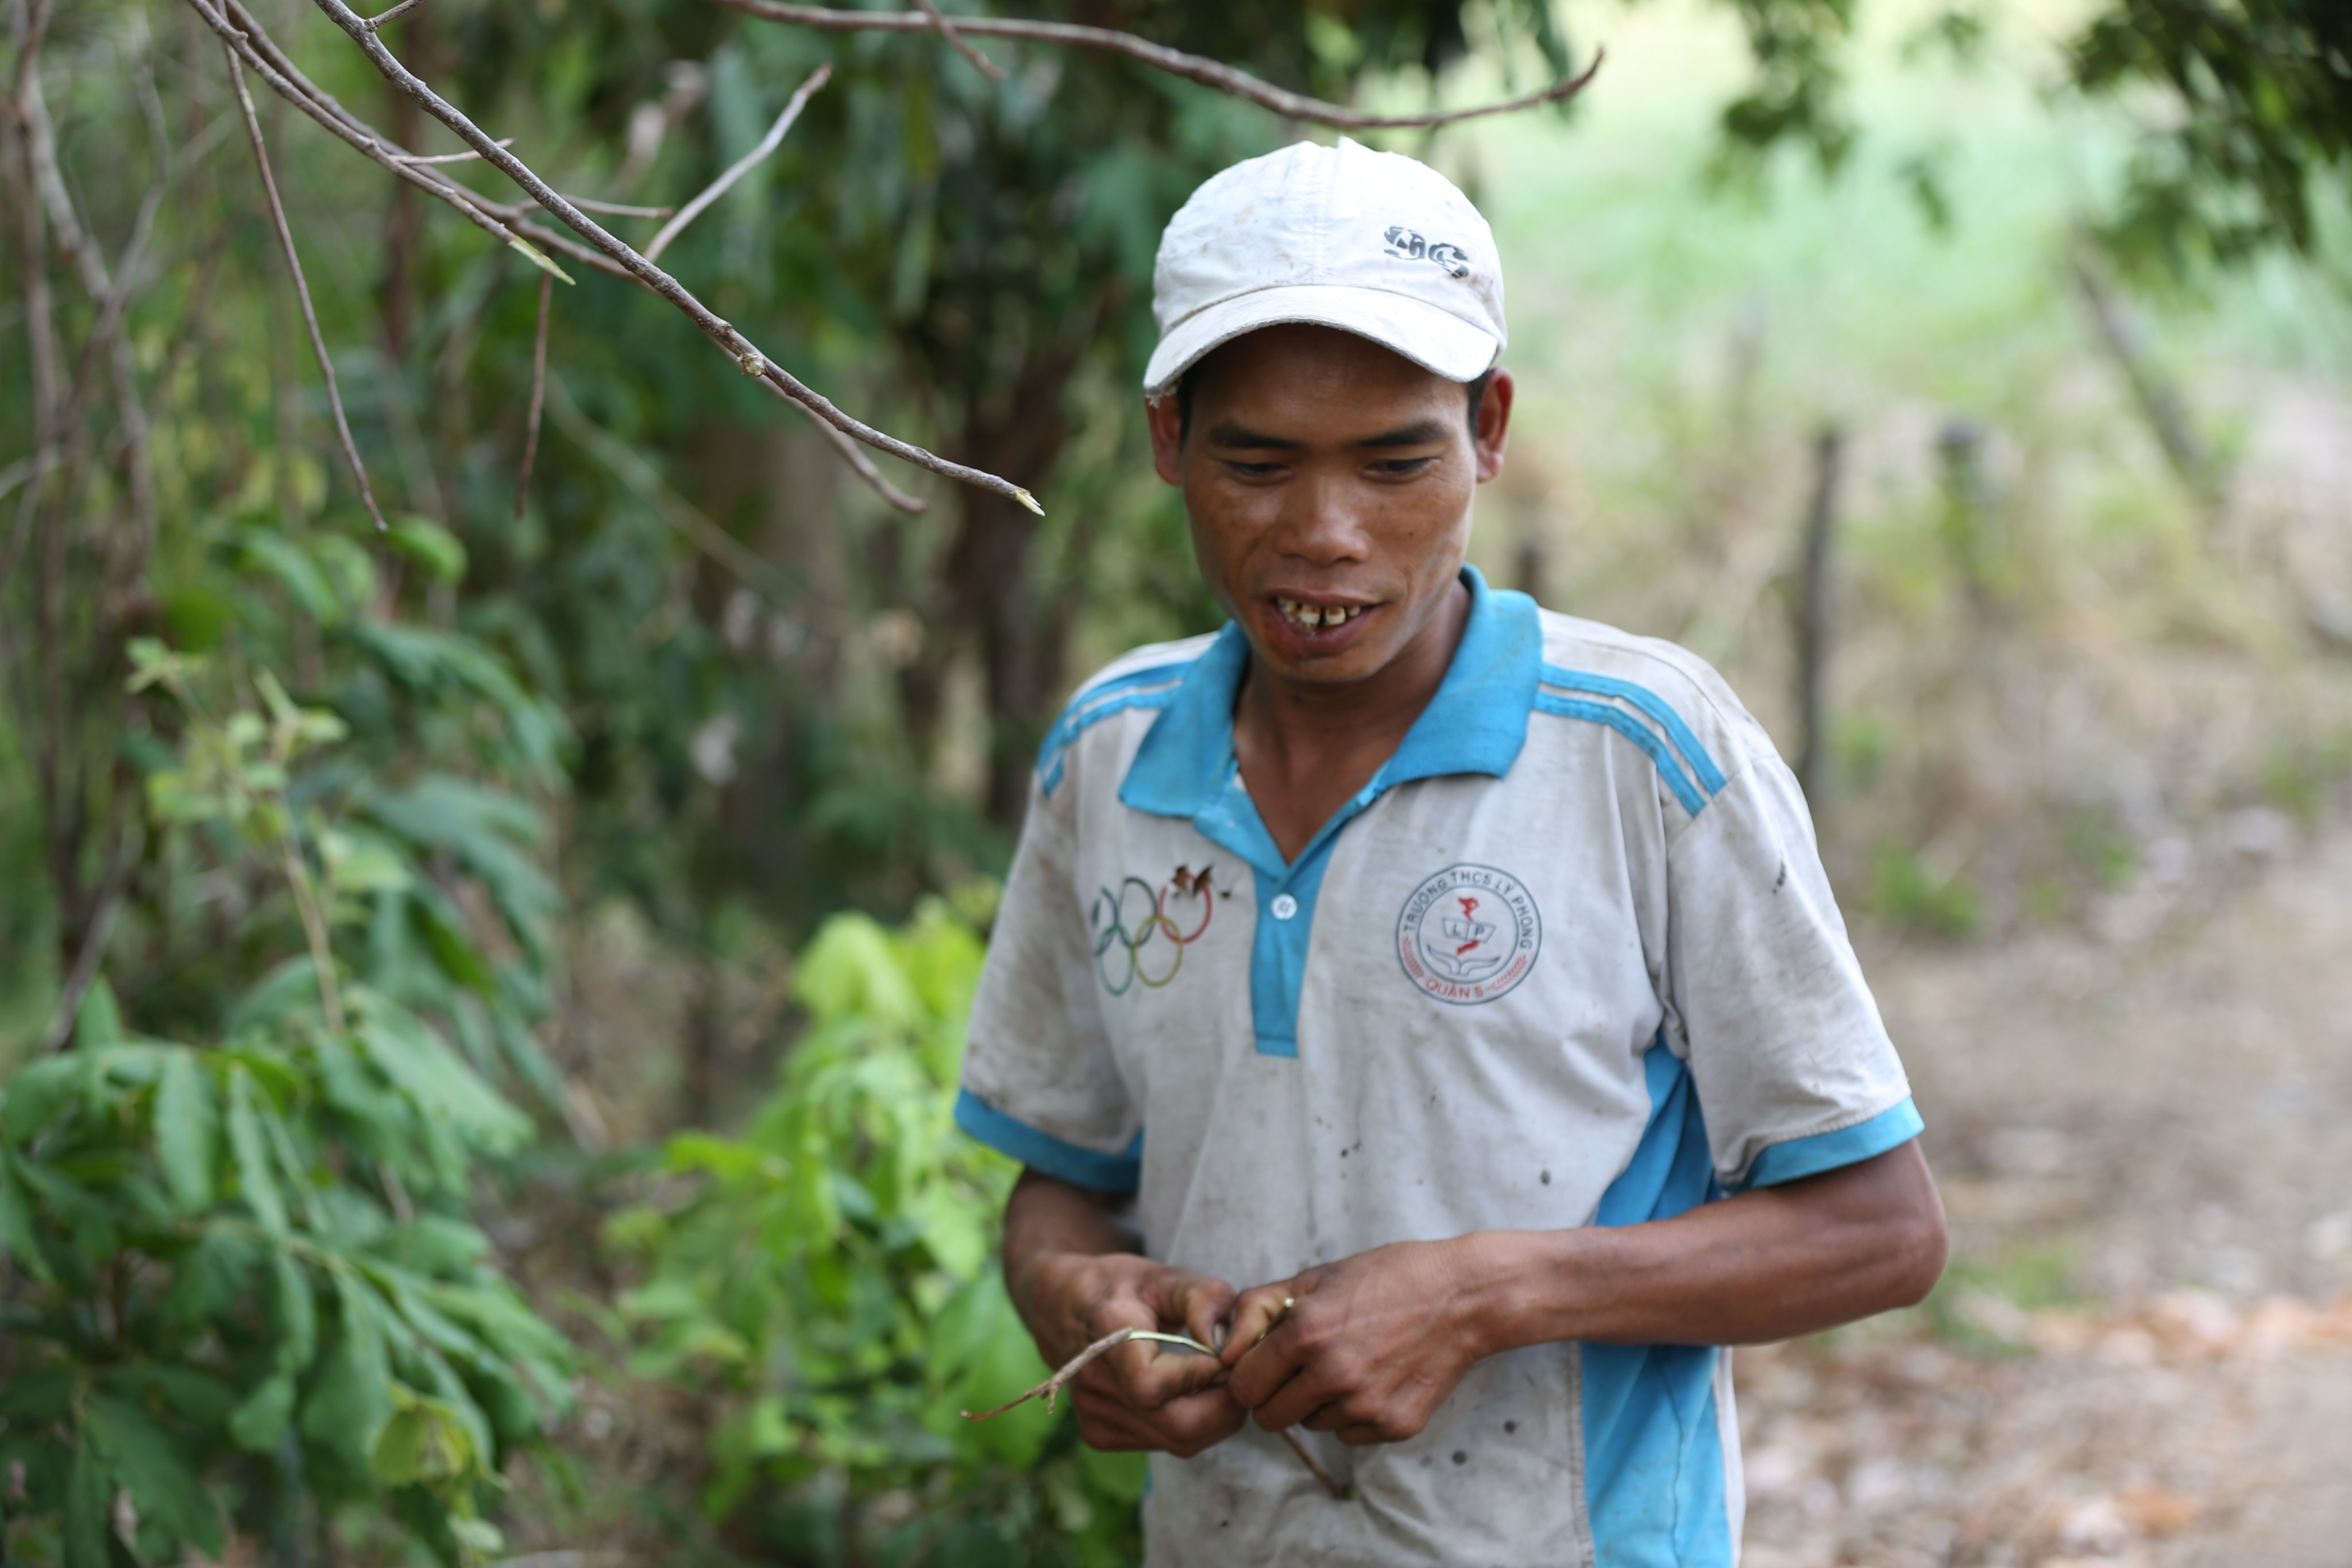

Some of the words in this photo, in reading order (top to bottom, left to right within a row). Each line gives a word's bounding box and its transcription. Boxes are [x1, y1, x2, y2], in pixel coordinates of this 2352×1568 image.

[1451, 871, 1493, 884] THCS
[1512, 896, 1534, 951] PHONG
[1452, 924, 1461, 937] L
[1475, 926, 1484, 937] P
